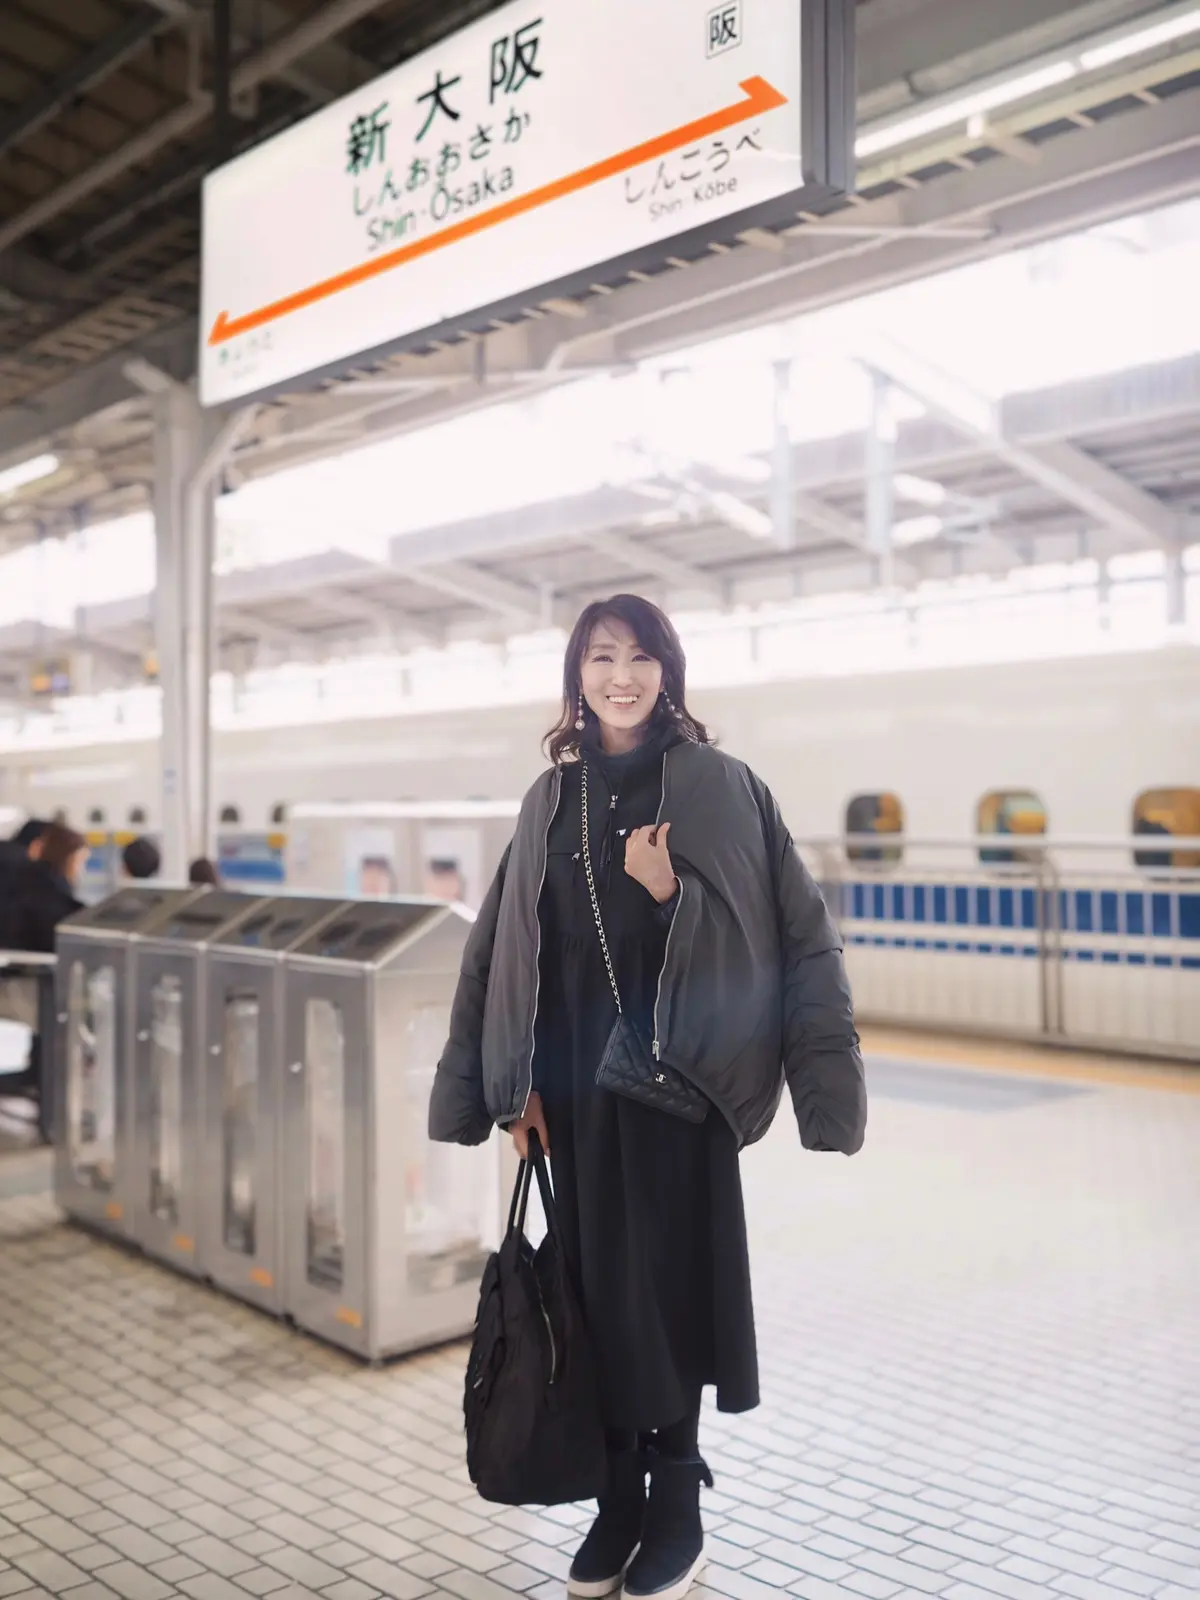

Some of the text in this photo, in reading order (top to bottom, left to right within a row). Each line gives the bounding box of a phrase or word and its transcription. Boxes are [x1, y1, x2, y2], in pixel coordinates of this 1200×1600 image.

[710, 5, 737, 51] 阪
[346, 18, 543, 177] 新大阪
[352, 107, 530, 217] しんおおさか
[624, 127, 762, 203] しんこうべ
